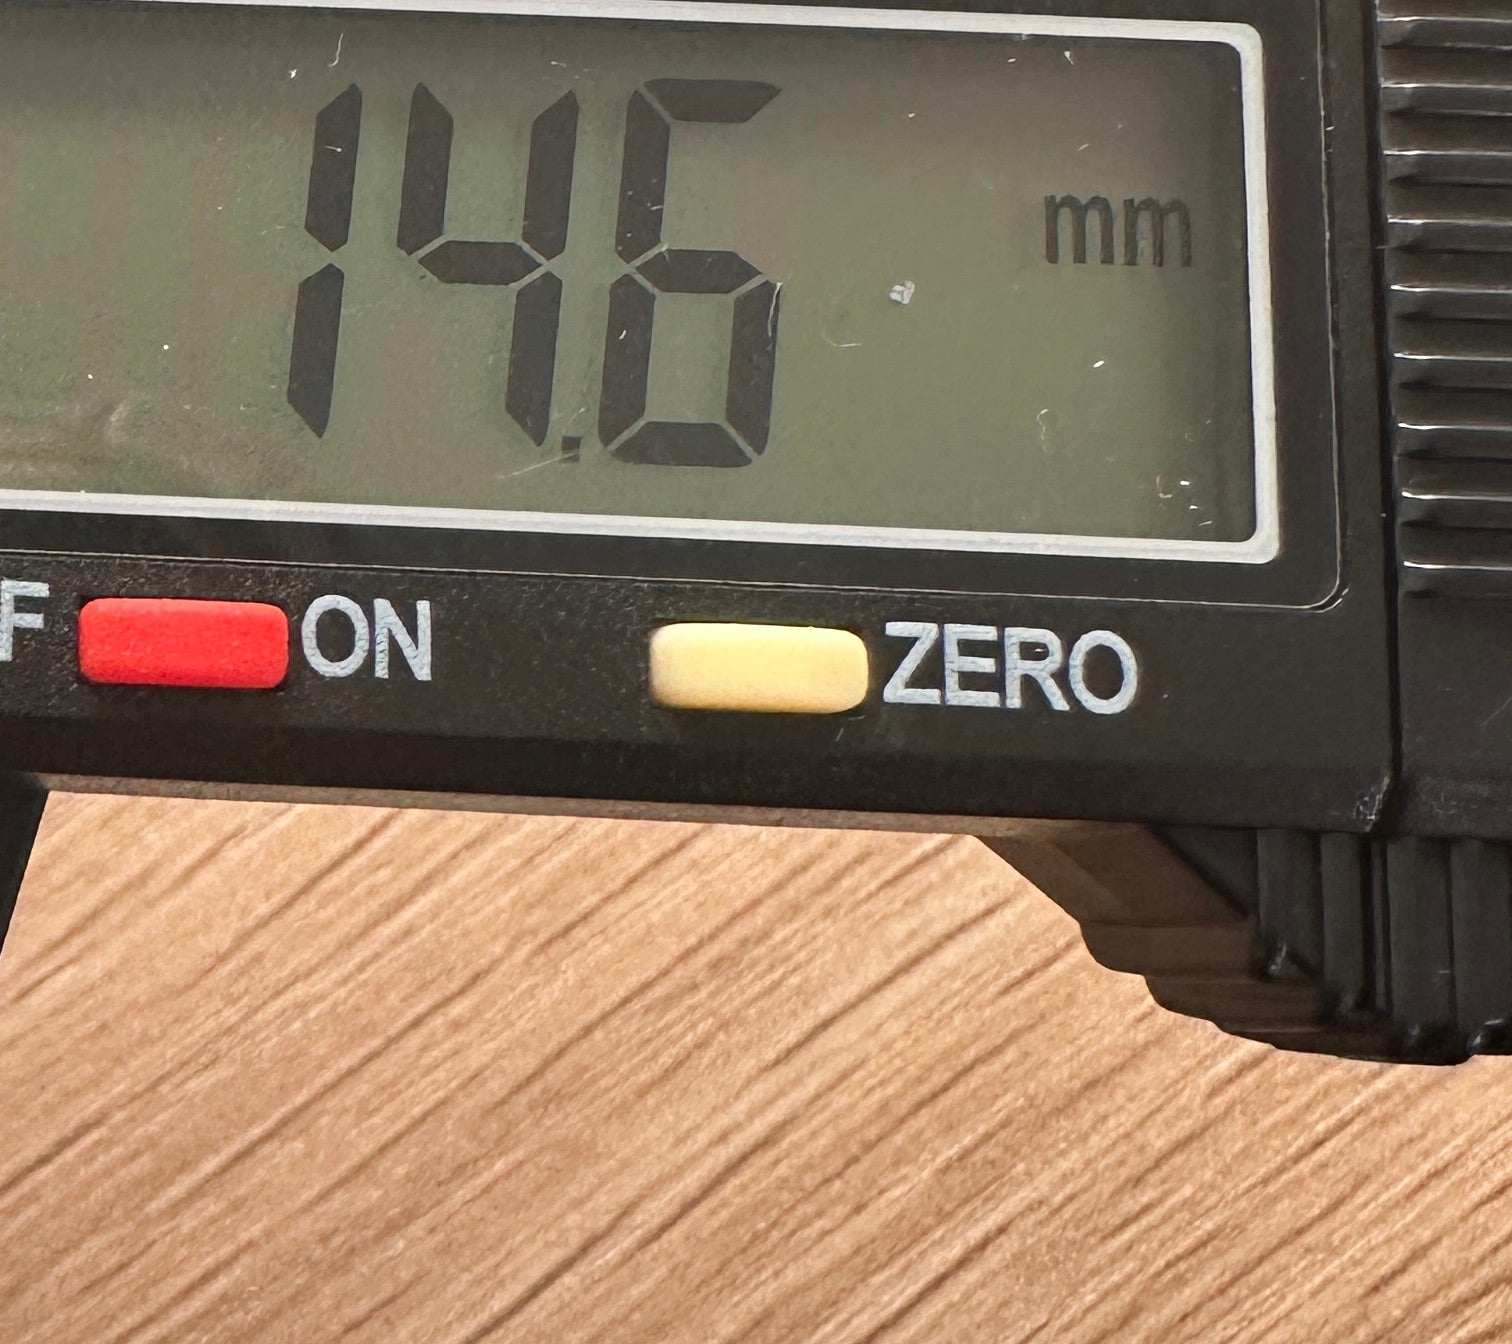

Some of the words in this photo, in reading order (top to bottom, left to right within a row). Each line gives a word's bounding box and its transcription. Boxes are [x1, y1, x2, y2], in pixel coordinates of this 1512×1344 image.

[288, 78, 782, 467] 14.6
[1043, 193, 1192, 267] mm
[301, 594, 432, 681] ON
[883, 621, 1139, 715] ZERO
